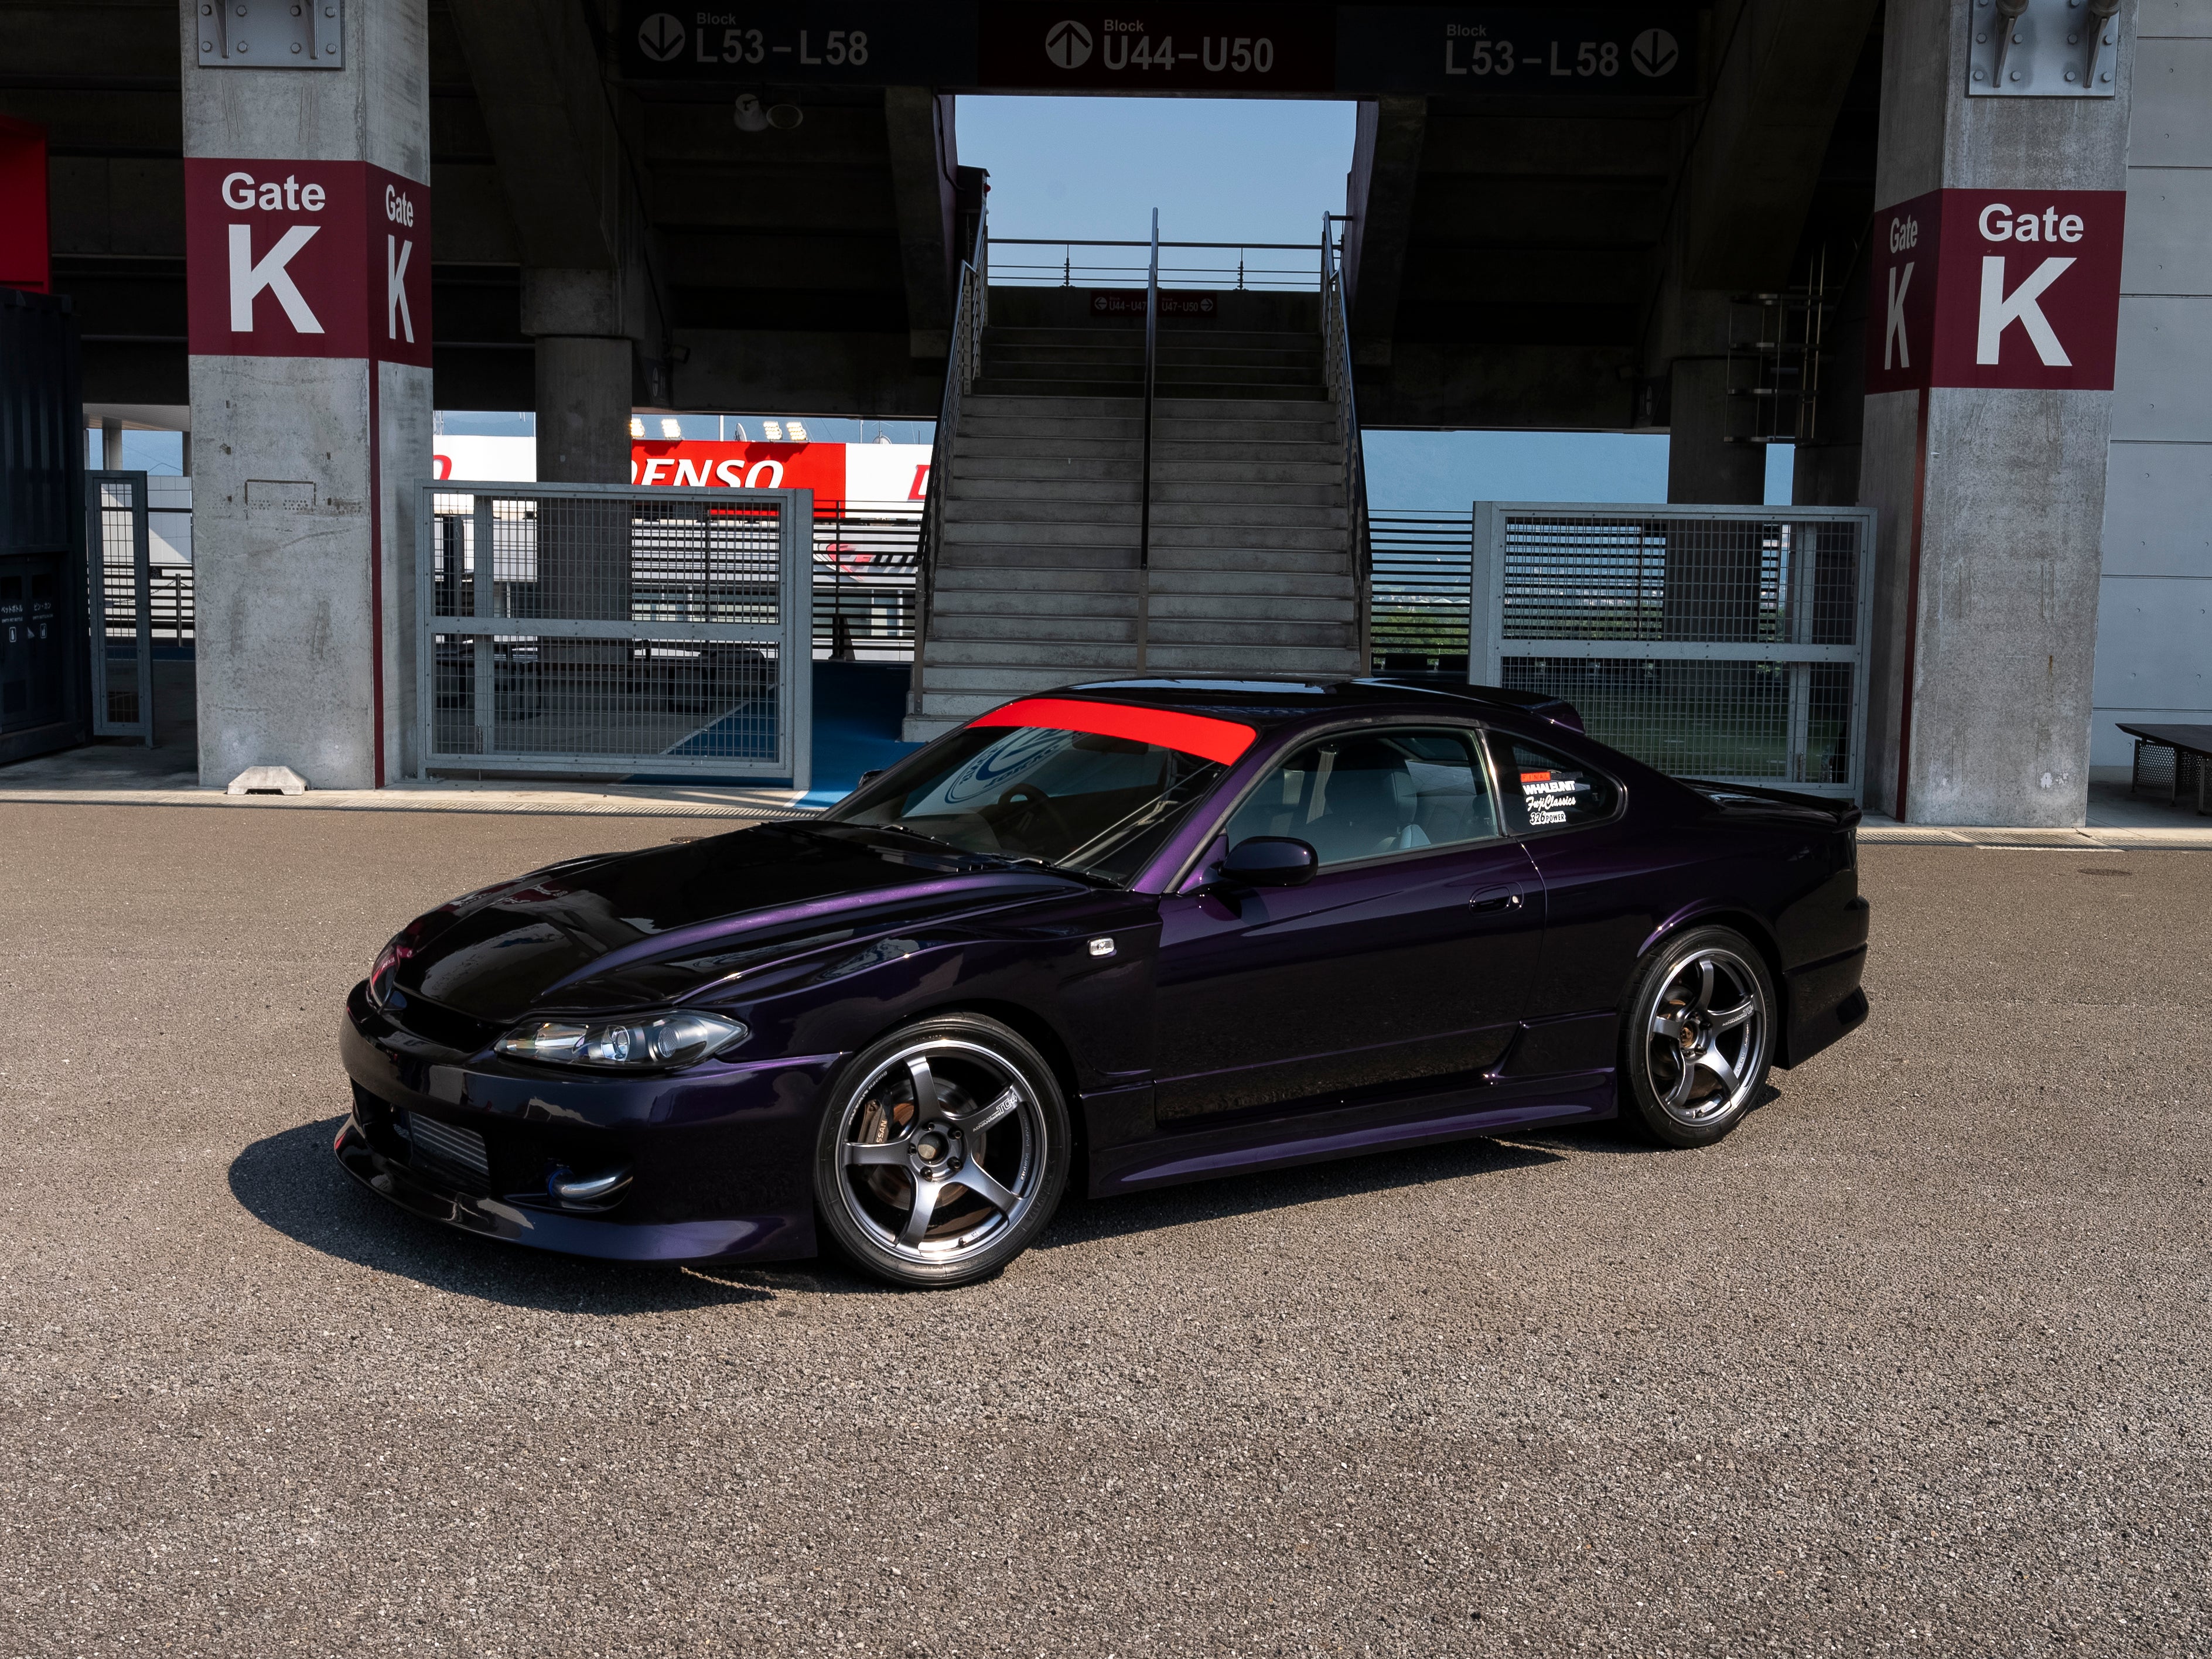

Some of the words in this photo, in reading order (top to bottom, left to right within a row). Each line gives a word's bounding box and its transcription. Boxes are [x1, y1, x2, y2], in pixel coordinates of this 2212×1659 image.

[697, 12, 736, 25] Block
[1104, 19, 1144, 32] Block
[1446, 24, 1486, 37] Block
[221, 172, 326, 211] Gate
[386, 184, 414, 228] Gate
[1890, 214, 1918, 254] Gate
[1978, 203, 2084, 243] Gate
[228, 224, 325, 334] K
[388, 234, 415, 343] K
[1884, 261, 1915, 370] K
[1976, 255, 2077, 367] K
